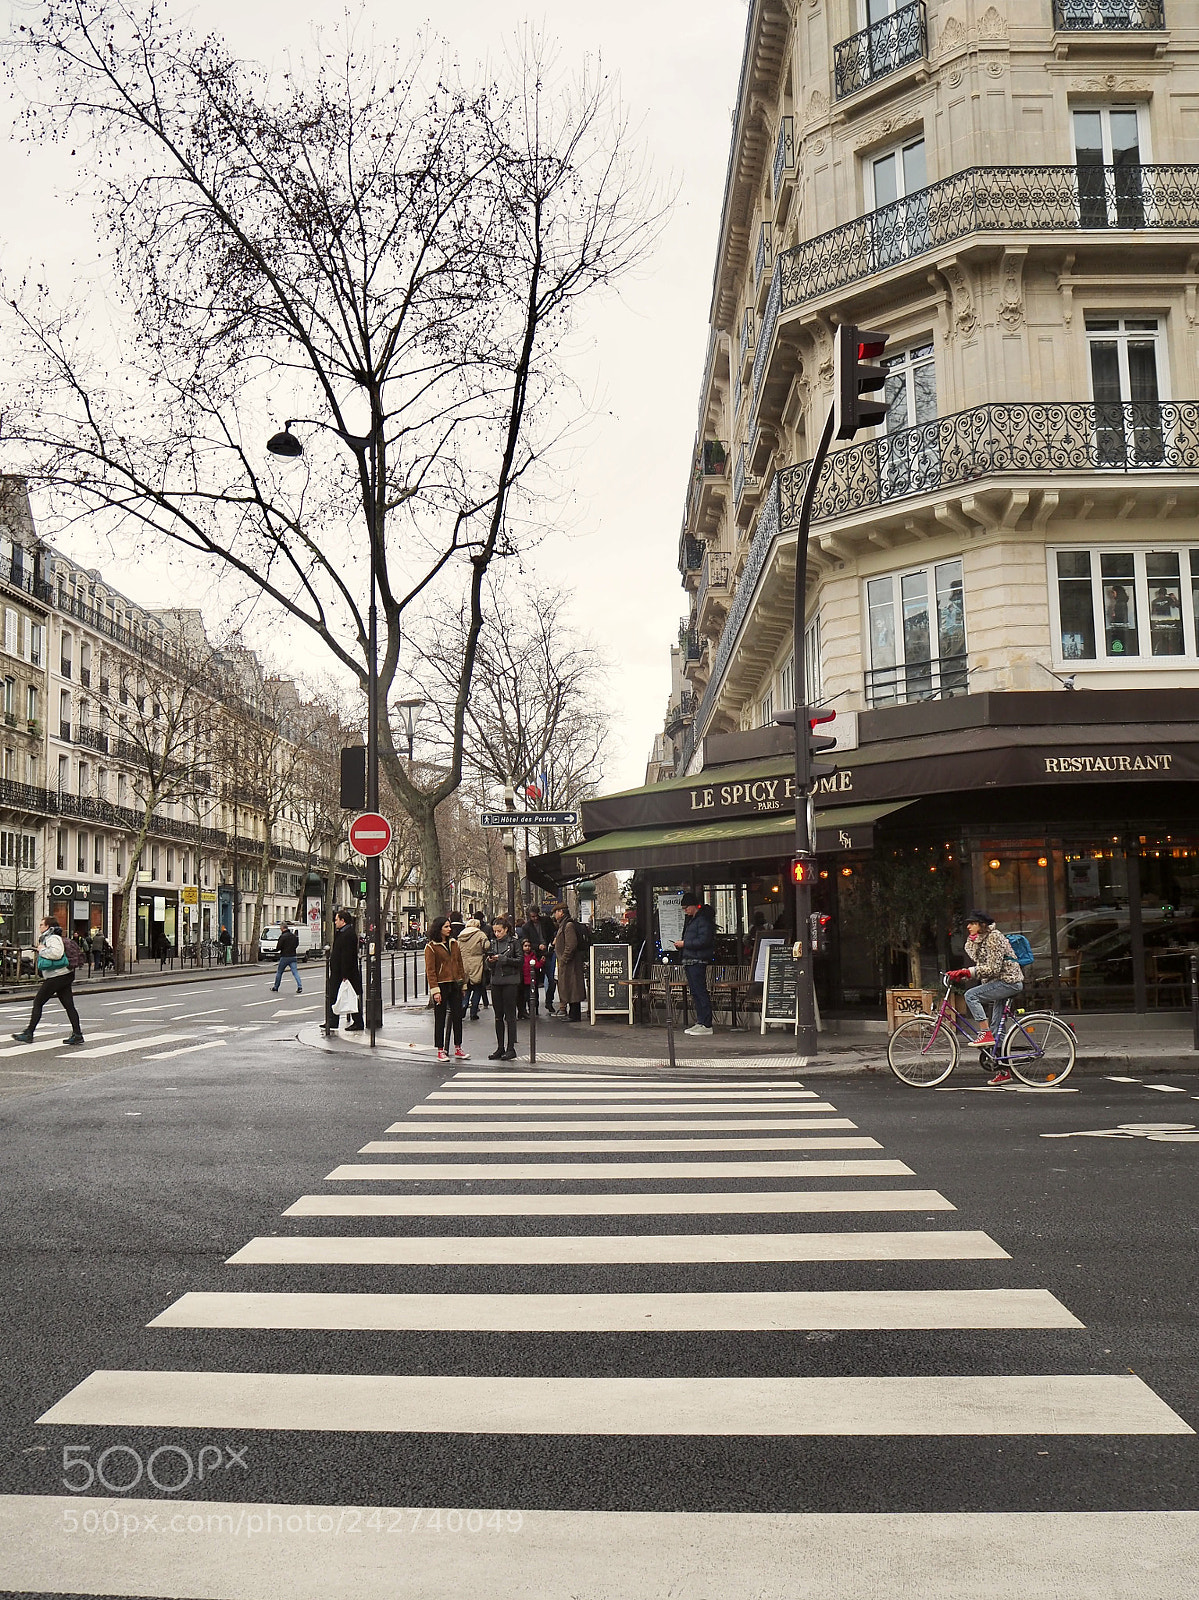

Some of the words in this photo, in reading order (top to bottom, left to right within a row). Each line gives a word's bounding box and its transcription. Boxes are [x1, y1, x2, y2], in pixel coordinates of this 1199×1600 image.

[1044, 754, 1172, 773] RESTAURANT
[690, 788, 715, 810] LE
[720, 779, 779, 806] SPICY
[608, 984, 615, 997] 5
